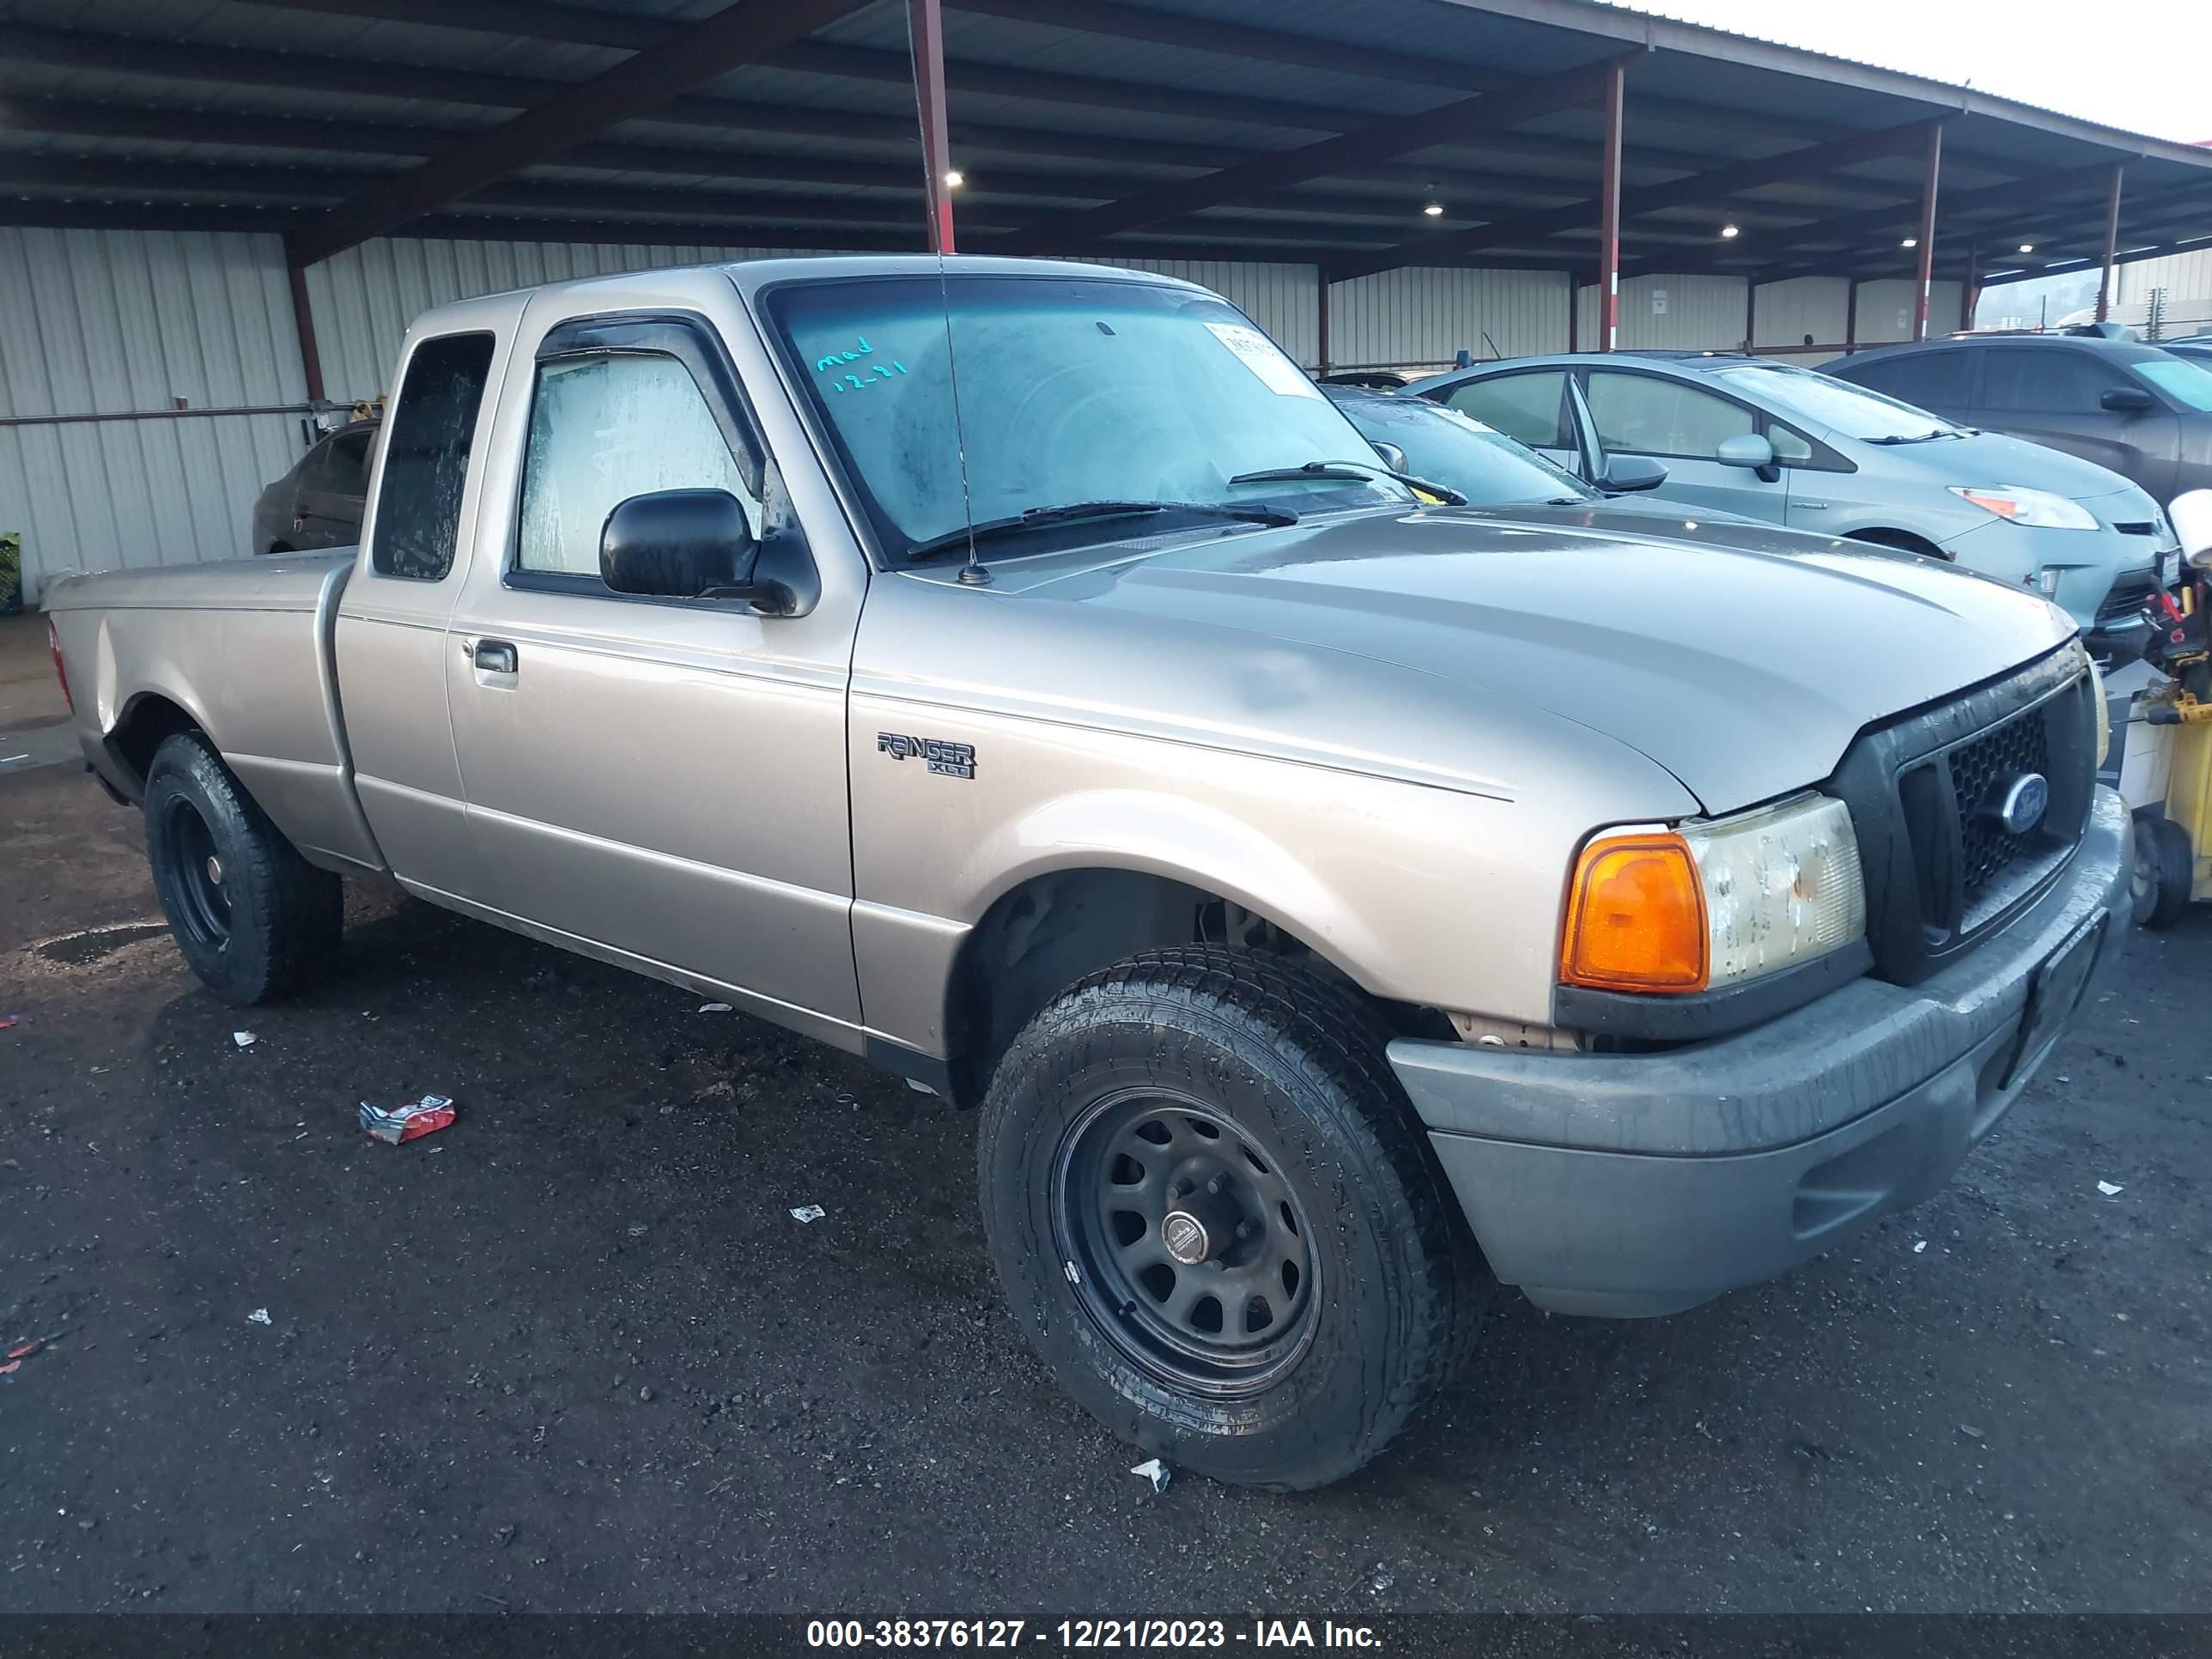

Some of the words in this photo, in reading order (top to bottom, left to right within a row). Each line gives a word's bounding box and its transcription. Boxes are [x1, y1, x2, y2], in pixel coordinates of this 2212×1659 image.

[832, 360, 908, 392] 12-21
[878, 732, 978, 766] RANGER
[930, 762, 972, 778] XLT
